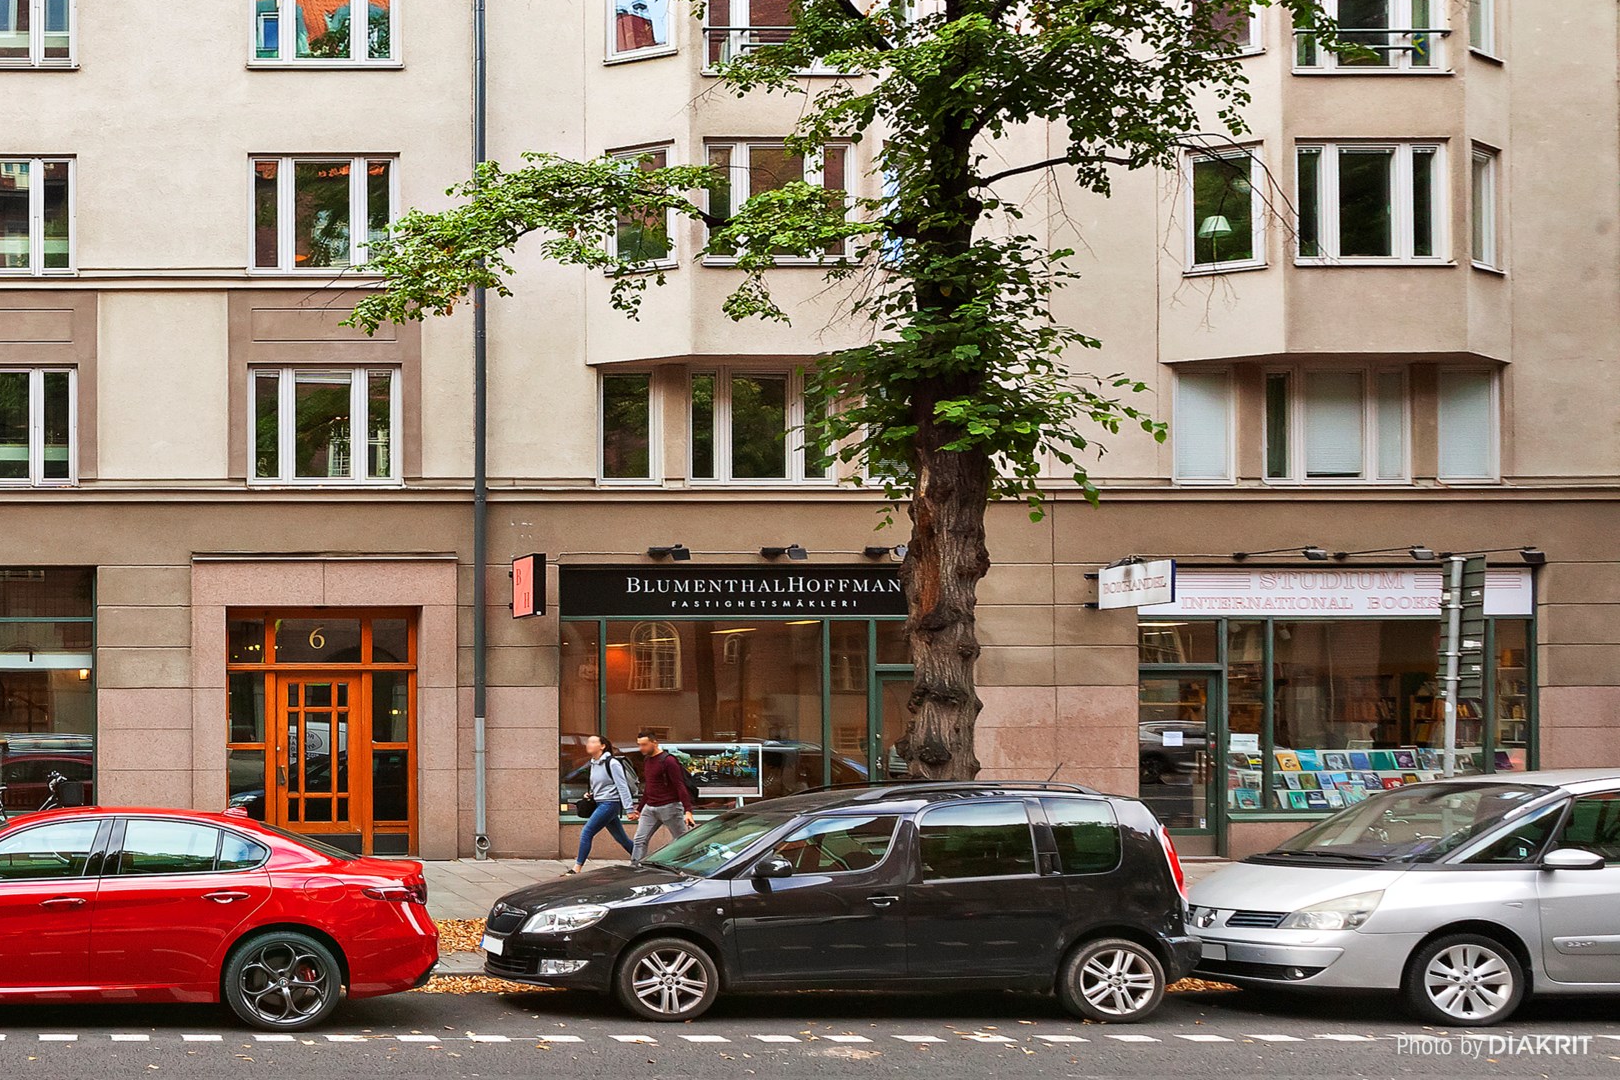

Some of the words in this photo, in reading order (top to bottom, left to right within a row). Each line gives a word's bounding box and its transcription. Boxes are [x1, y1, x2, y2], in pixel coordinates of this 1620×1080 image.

[515, 568, 522, 586] B
[1102, 576, 1167, 595] BOKHANDEL
[1259, 571, 1405, 591] STUDIUM
[671, 599, 857, 608] FASTIGHETSMÄKLERI
[1181, 596, 1354, 610] INTERNATIONAL
[1367, 596, 1440, 610] BOOKS
[309, 626, 325, 650] 6
